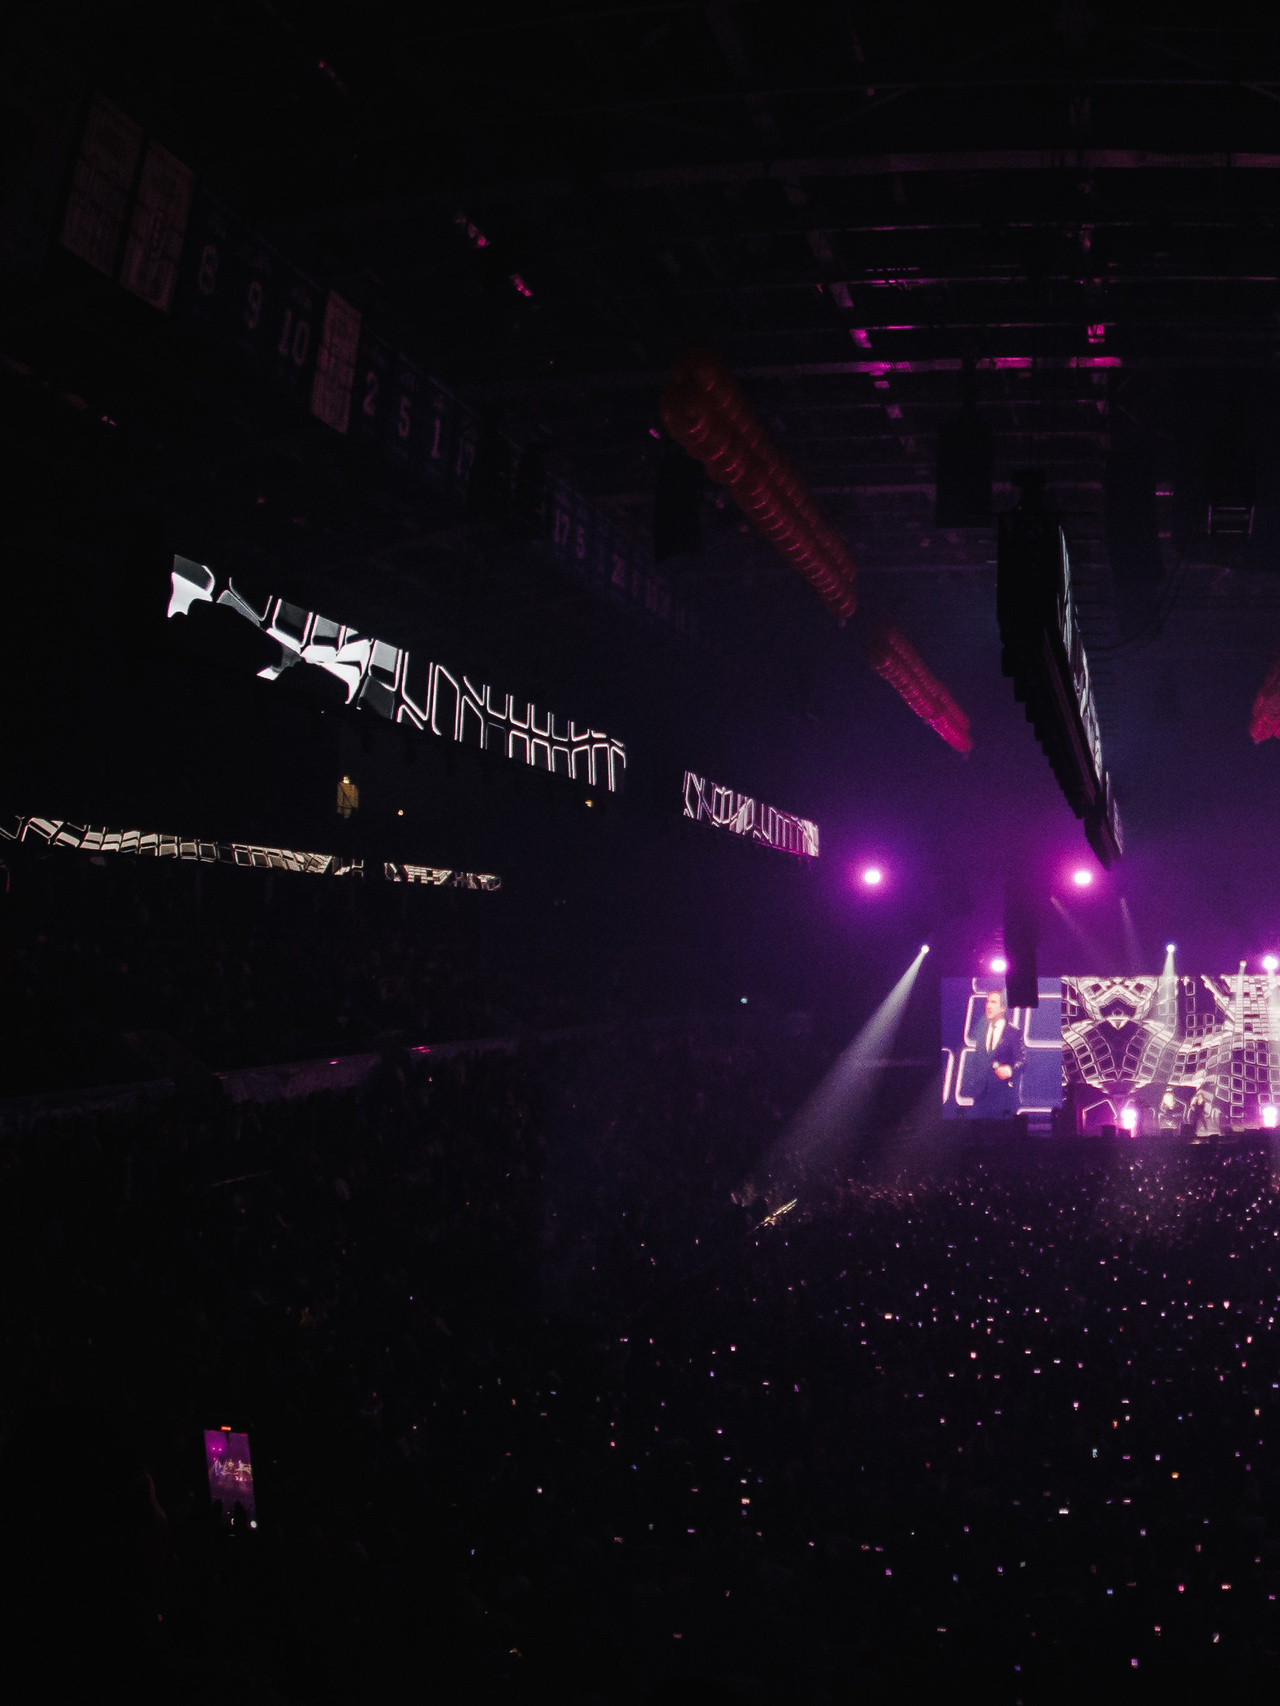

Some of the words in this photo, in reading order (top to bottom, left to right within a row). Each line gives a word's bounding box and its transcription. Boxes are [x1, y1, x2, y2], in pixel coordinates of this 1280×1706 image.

[277, 308, 311, 367] 10
[362, 371, 380, 416] 2
[396, 395, 412, 439] 5
